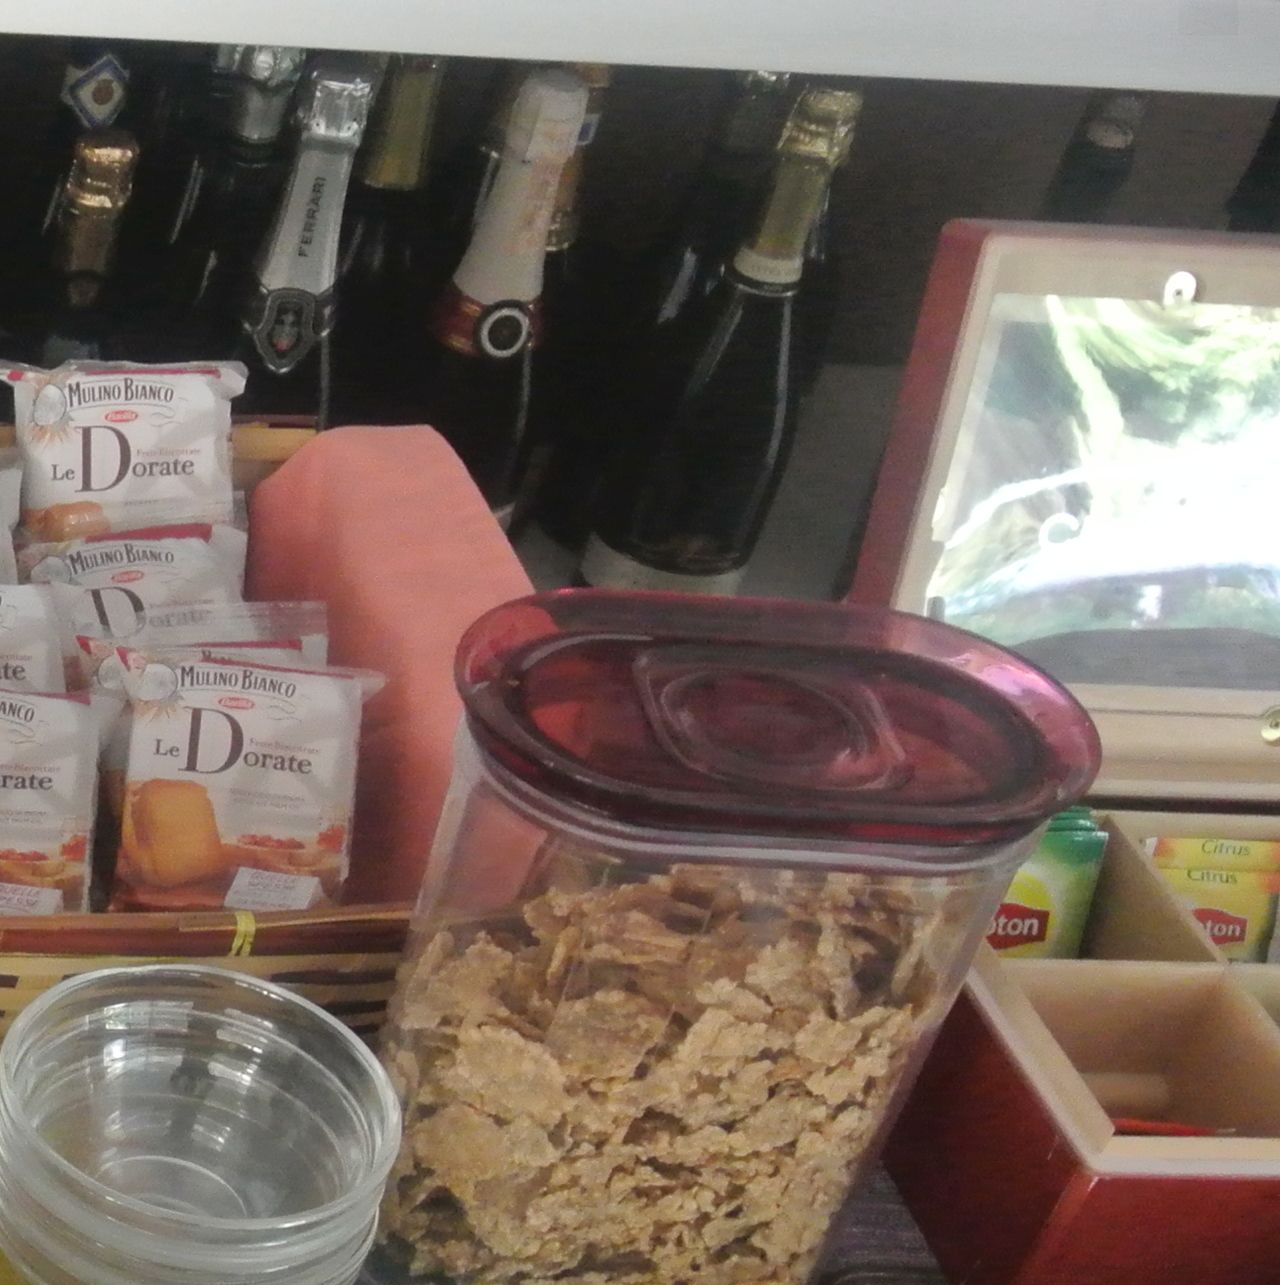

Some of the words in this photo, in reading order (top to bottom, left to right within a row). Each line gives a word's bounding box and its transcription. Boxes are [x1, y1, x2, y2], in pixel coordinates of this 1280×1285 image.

[297, 174, 327, 259] FERRARI
[68, 381, 121, 408] MULINO
[124, 378, 174, 403] BIANCO
[51, 464, 75, 481] Le
[75, 425, 195, 493] Dorate
[69, 548, 124, 575] MULINO
[126, 543, 174, 564] BIANCO
[180, 665, 238, 688] MULINO
[241, 669, 296, 698] BIANCO
[153, 739, 180, 757] Le
[178, 706, 313, 774] Dorate
[1201, 839, 1251, 858] Citrus
[1187, 868, 1238, 886] Citrus
[1205, 921, 1241, 937] ton
